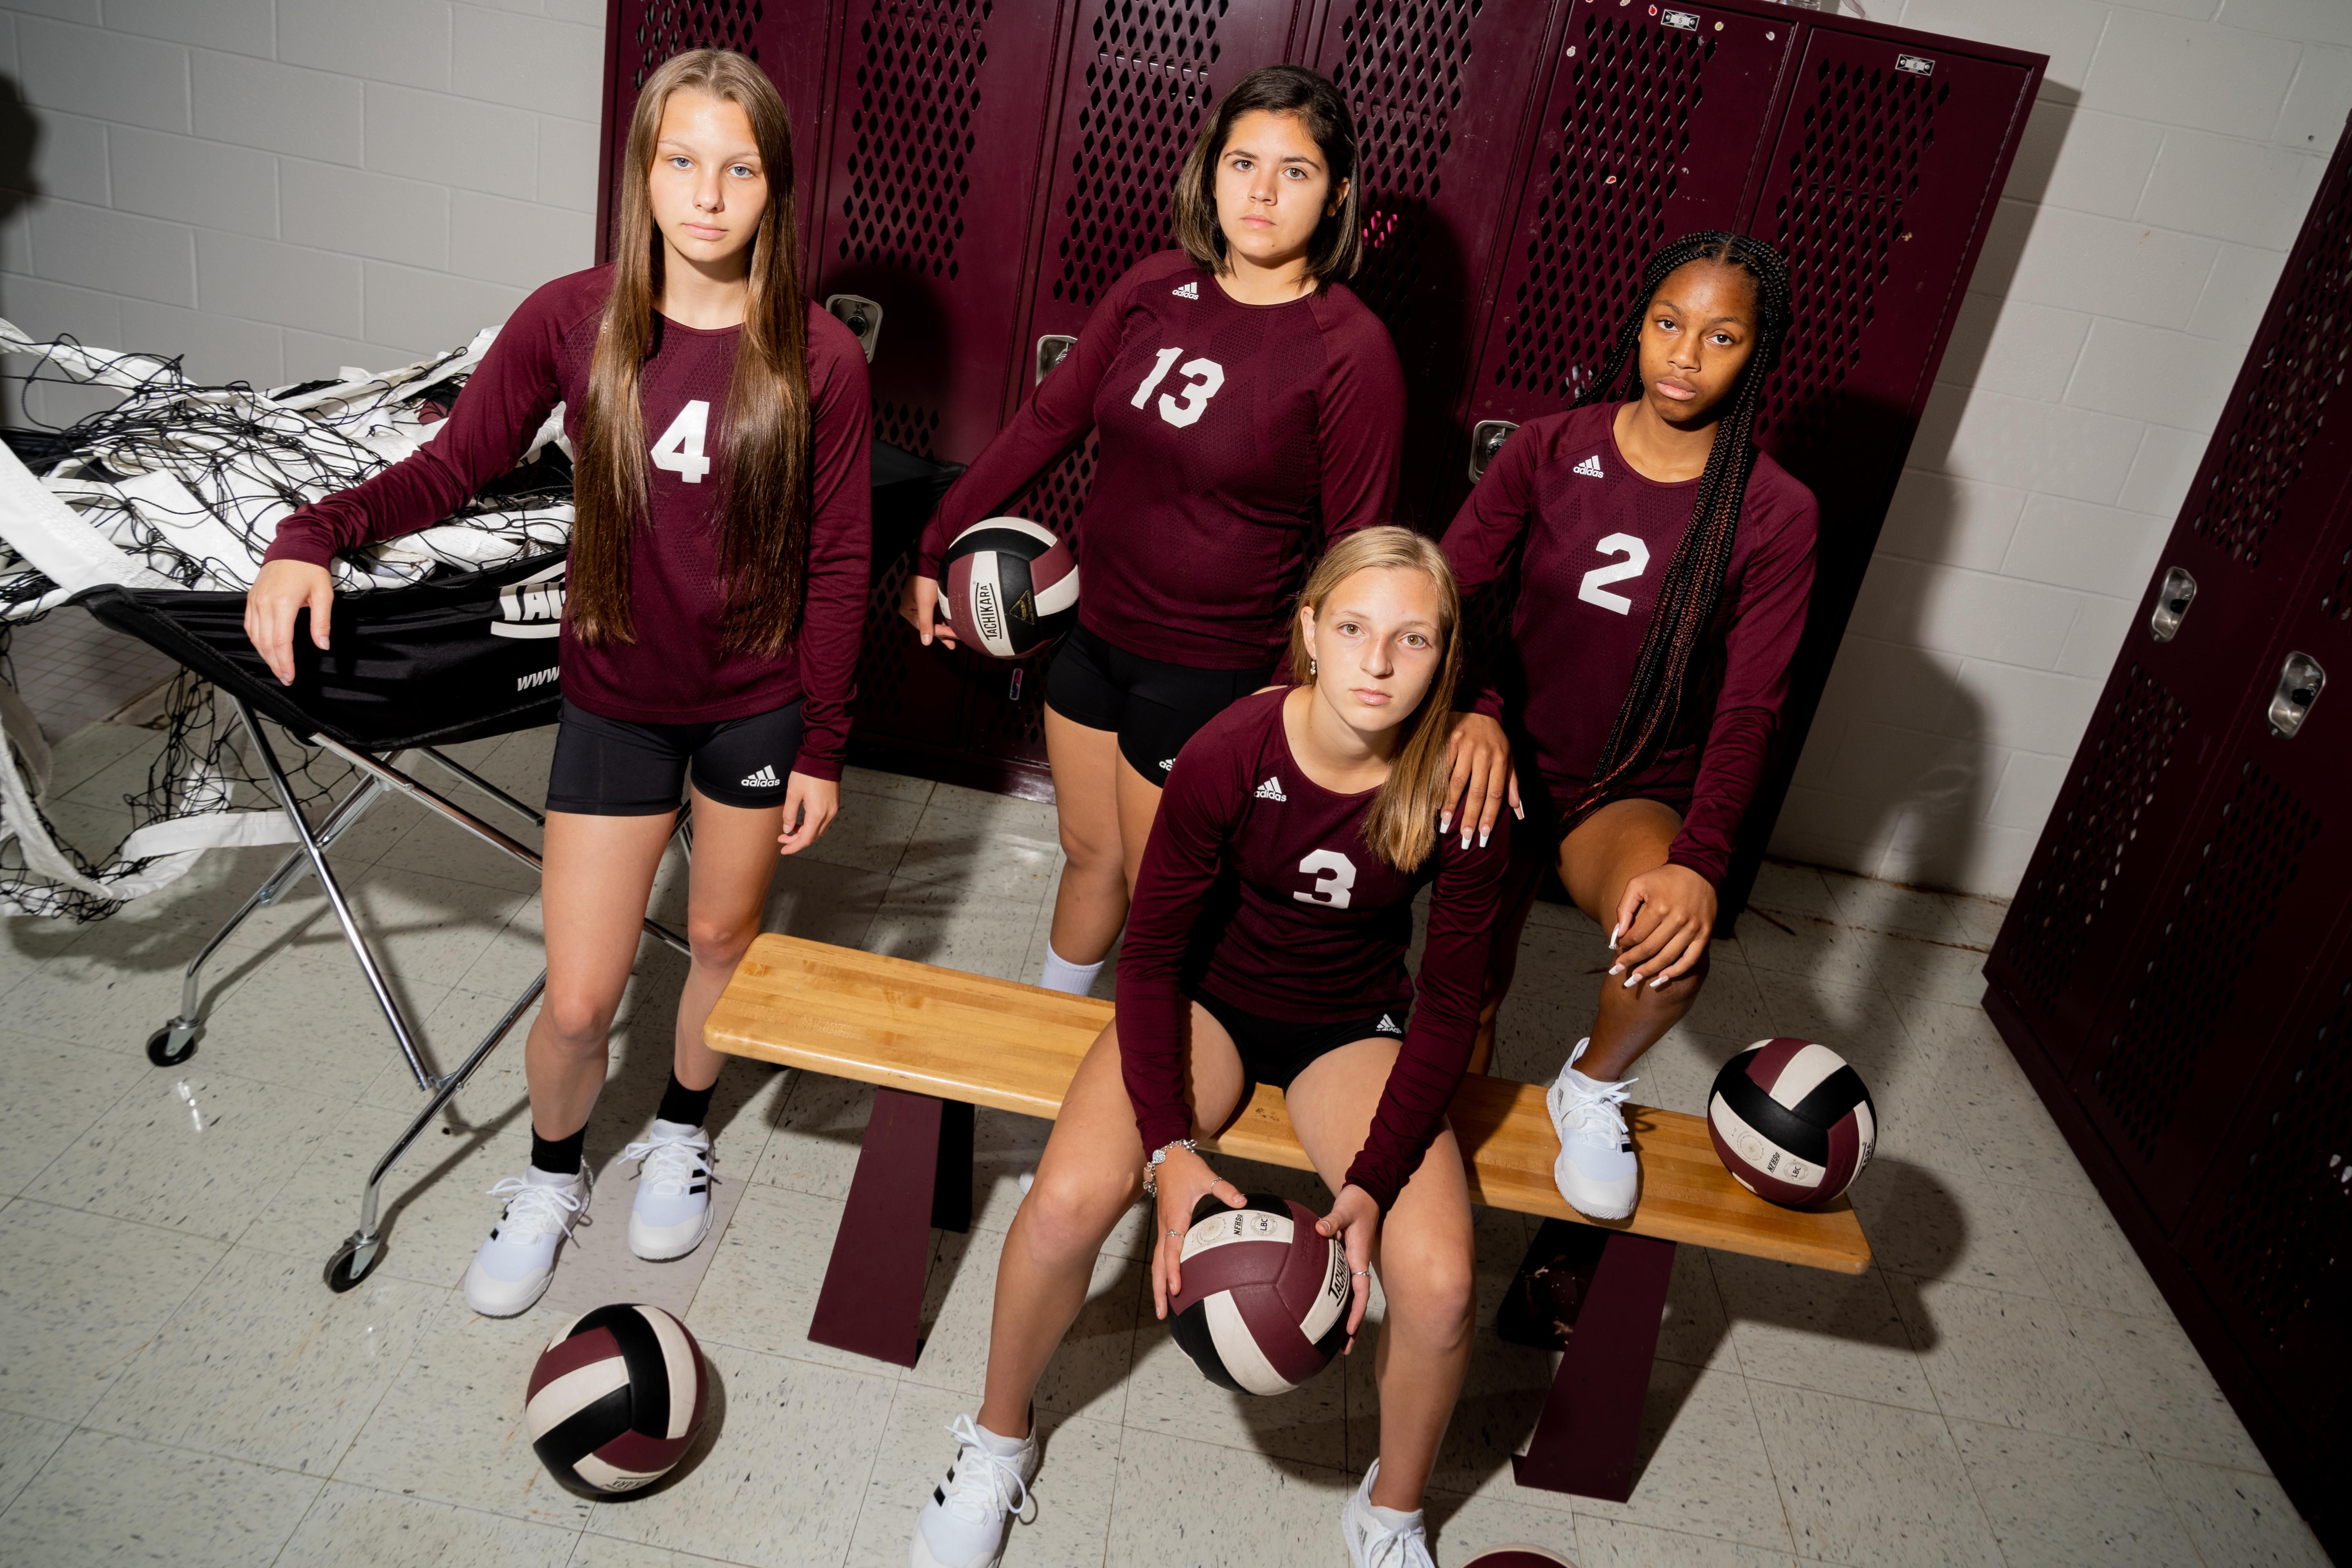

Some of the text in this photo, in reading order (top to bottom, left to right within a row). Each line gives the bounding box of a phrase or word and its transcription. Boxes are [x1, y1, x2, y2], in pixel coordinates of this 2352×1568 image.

[1172, 289, 1199, 300] adidas
[1130, 347, 1225, 428] 13
[650, 399, 710, 483] 4
[1573, 466, 1604, 478] adidas
[1577, 532, 1650, 616] 2
[978, 585, 998, 641] TACHIKARA
[741, 779, 780, 787] adidas
[1254, 789, 1287, 802] adidas
[1293, 849, 1357, 909] 3
[1790, 1165, 1802, 1178] LBC
[1259, 1218, 1268, 1231] LBC
